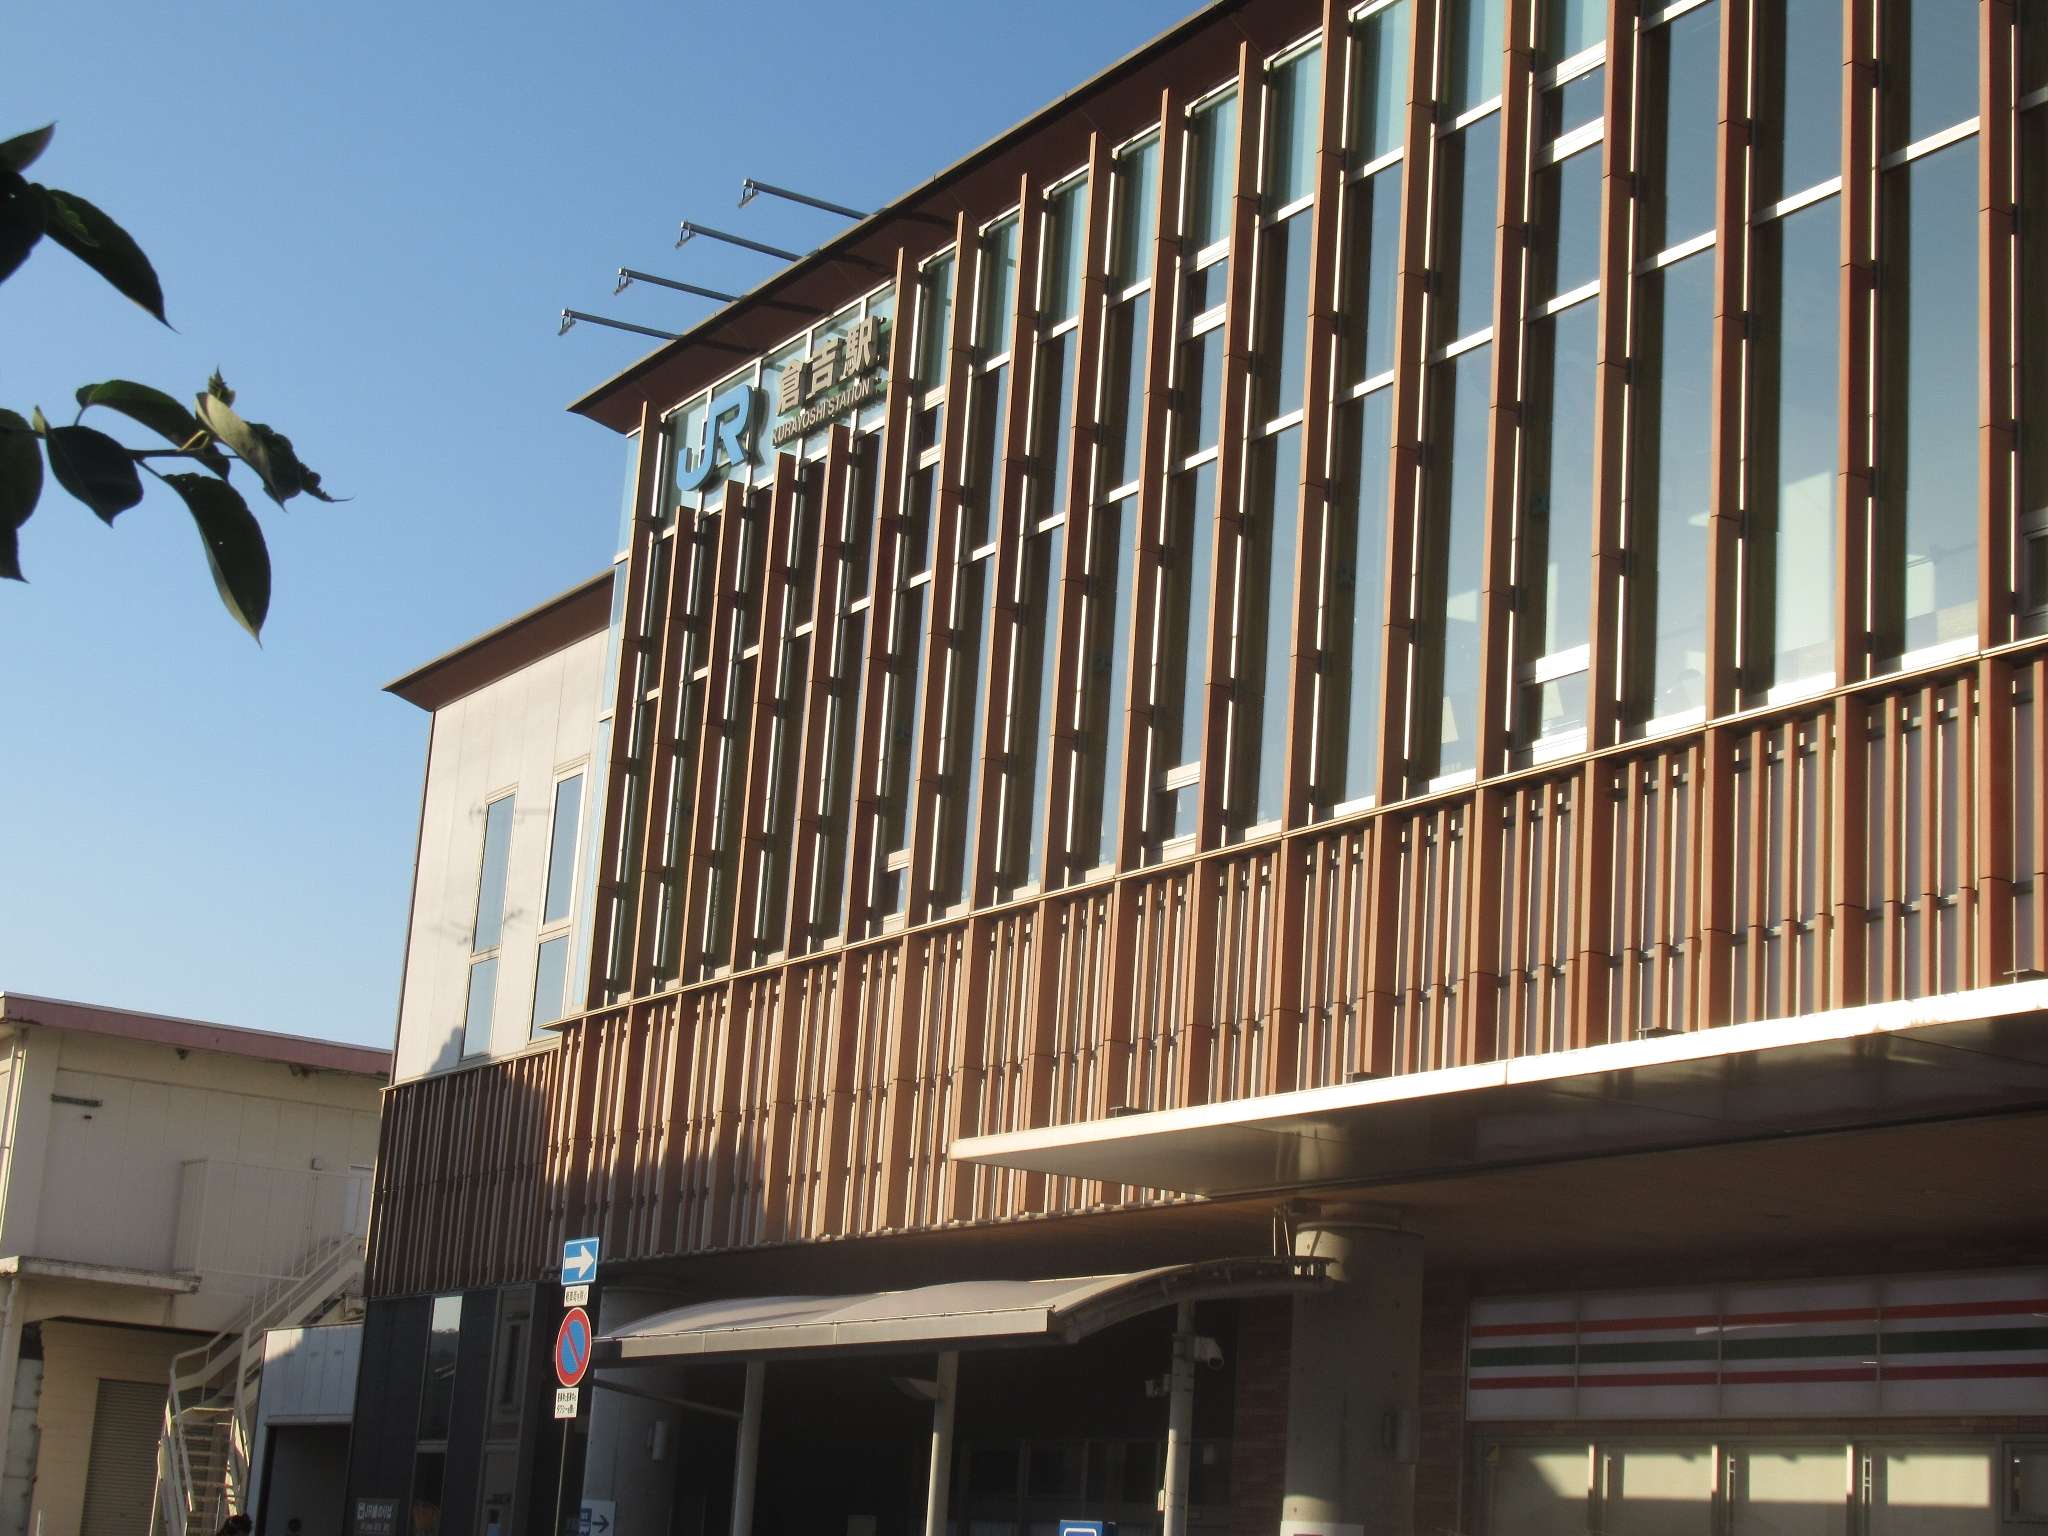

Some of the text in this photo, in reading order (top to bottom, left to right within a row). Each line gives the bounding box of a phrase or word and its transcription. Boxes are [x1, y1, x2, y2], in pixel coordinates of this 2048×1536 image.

[774, 378, 870, 444] KURAYOSHI STATION
[776, 317, 875, 416] 倉吉駅
[676, 384, 752, 491] JR
